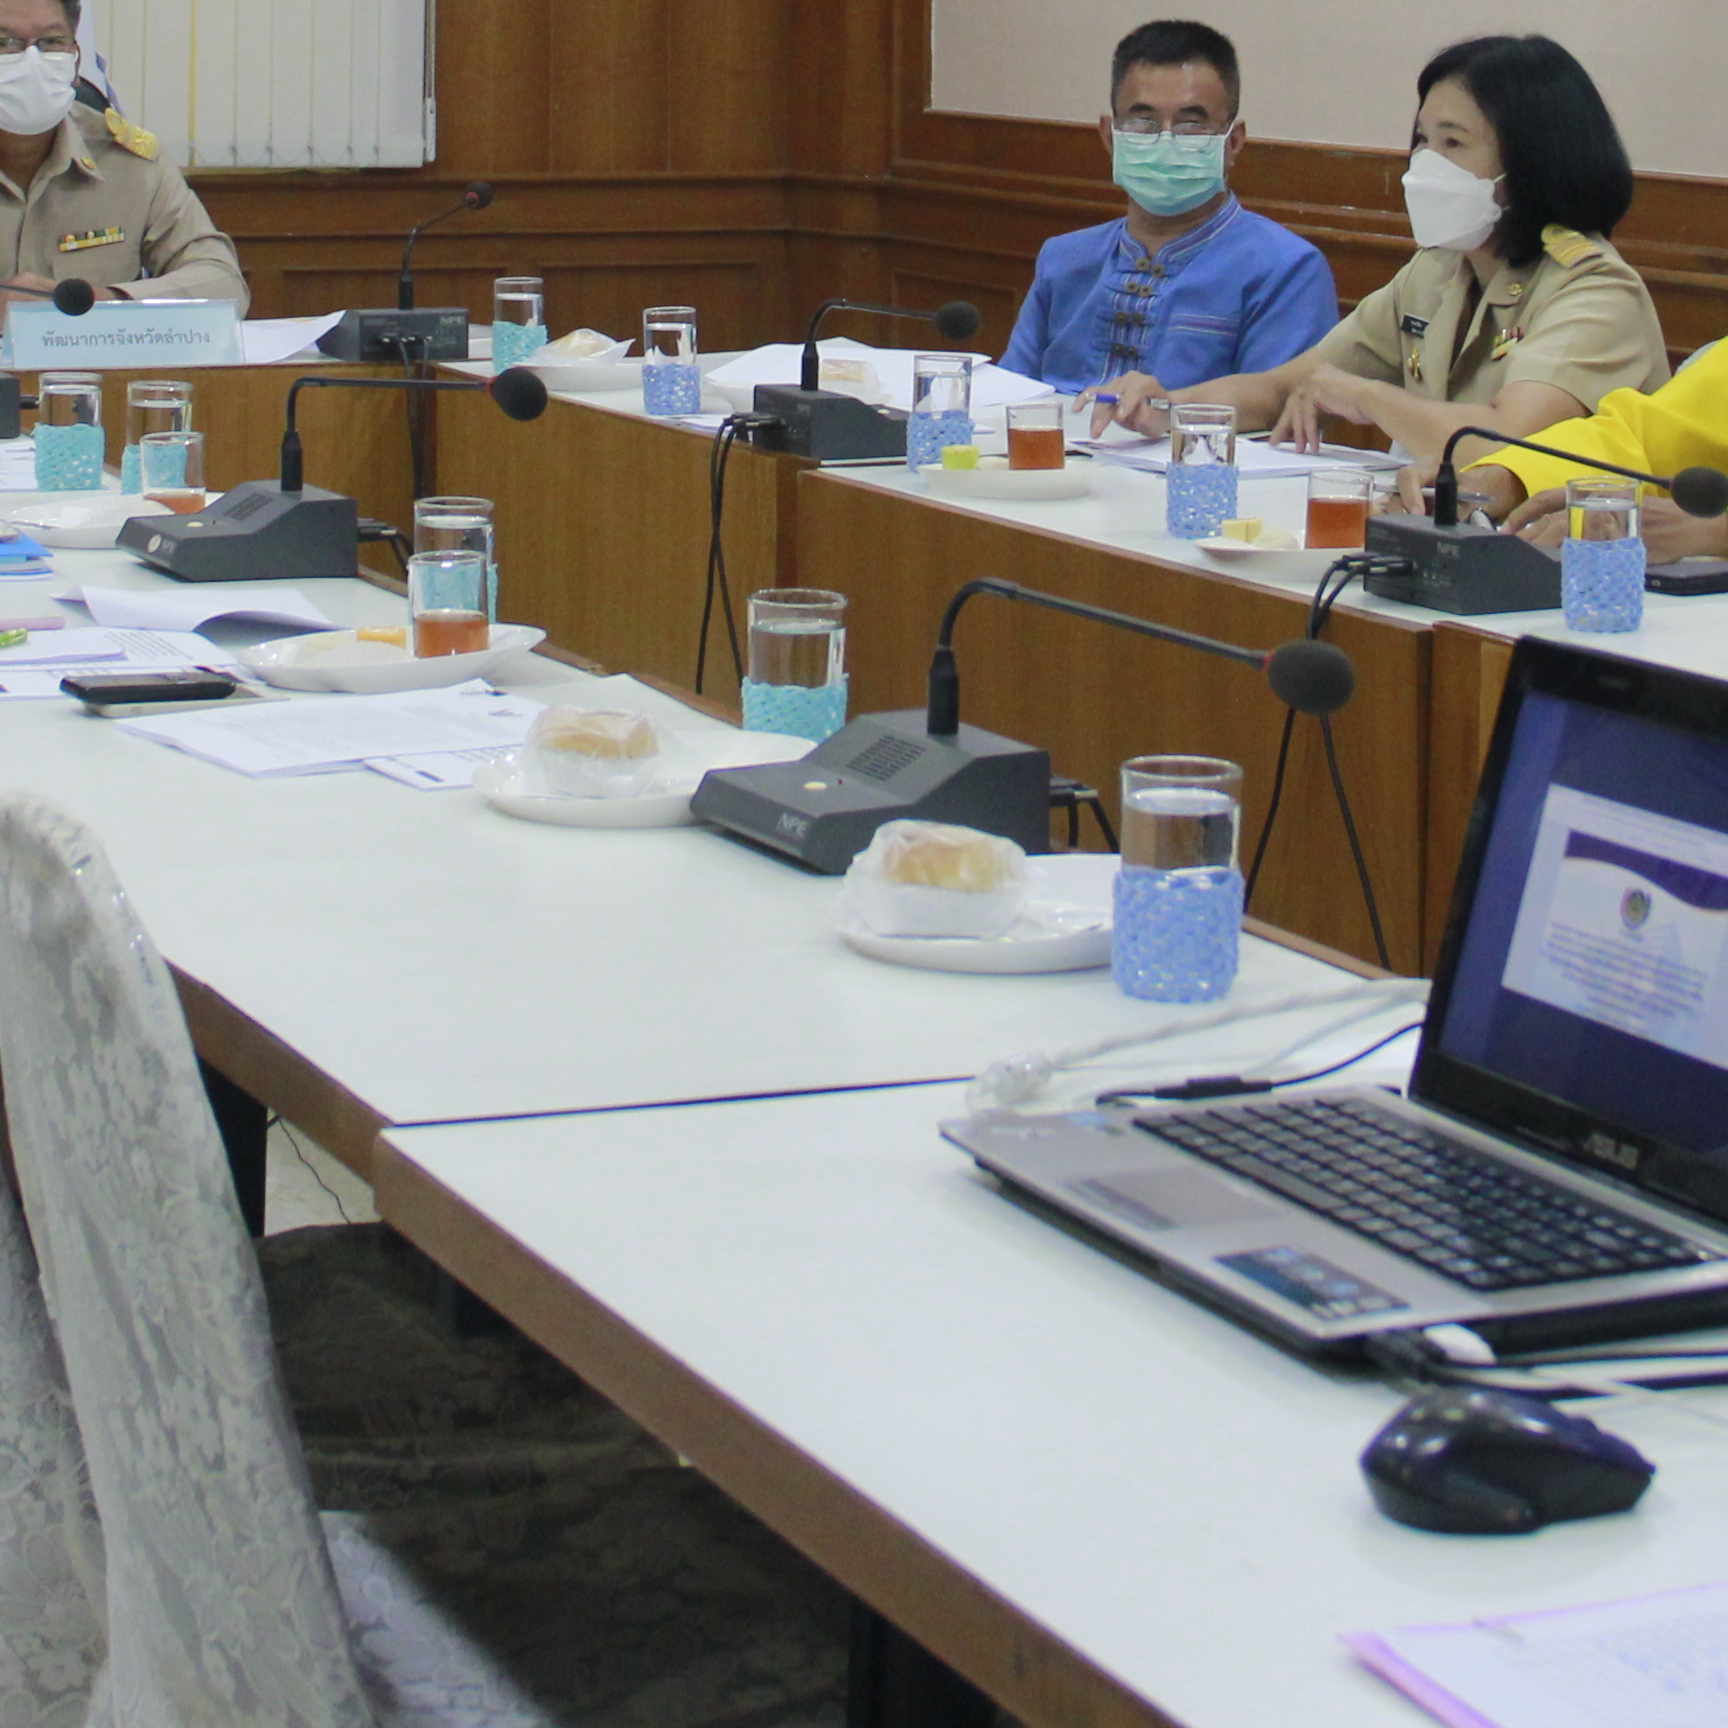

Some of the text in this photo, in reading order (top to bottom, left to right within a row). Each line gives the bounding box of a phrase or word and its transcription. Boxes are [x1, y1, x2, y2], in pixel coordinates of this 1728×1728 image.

[41, 327, 210, 348] พัฒนาการจังหวัดลำปาง
